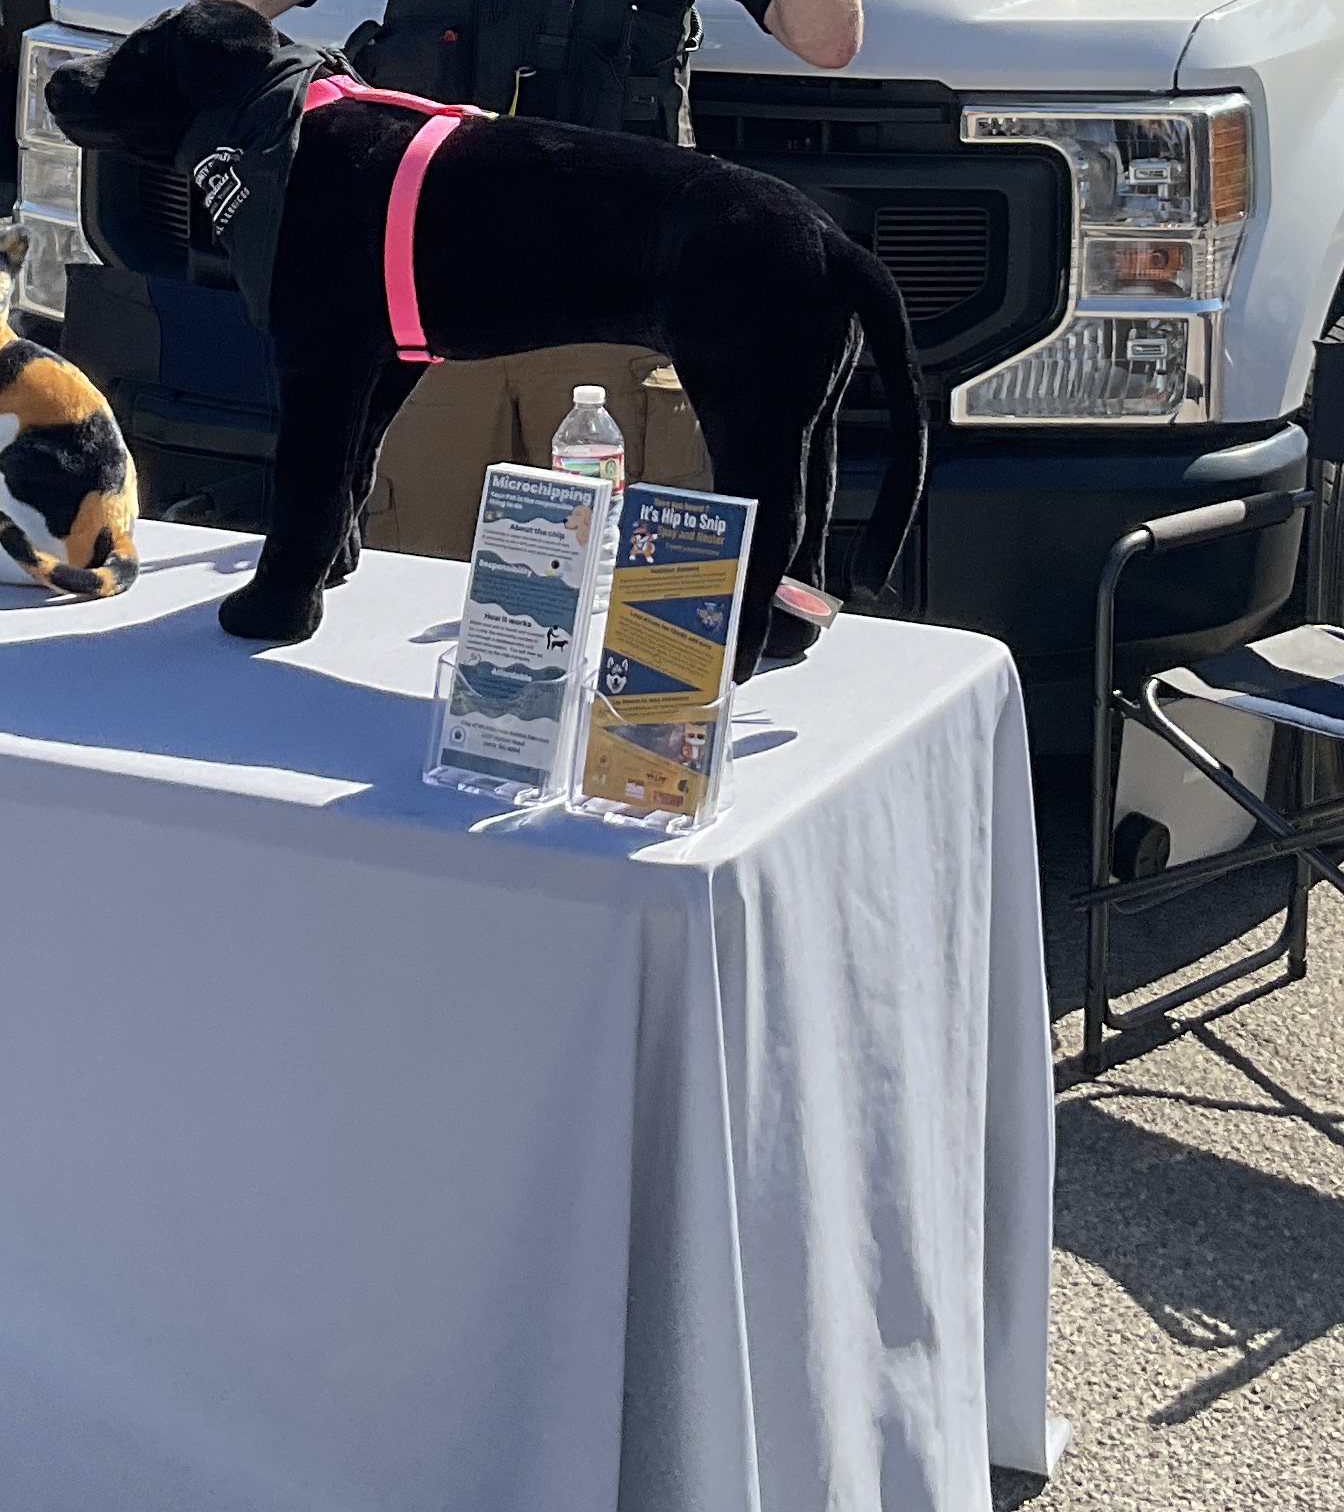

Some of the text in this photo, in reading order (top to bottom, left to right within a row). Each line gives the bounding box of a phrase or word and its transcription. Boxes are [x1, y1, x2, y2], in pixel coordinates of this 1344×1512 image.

[492, 475, 592, 505] Microchipping
[640, 504, 726, 536] It's Hip to Snip
